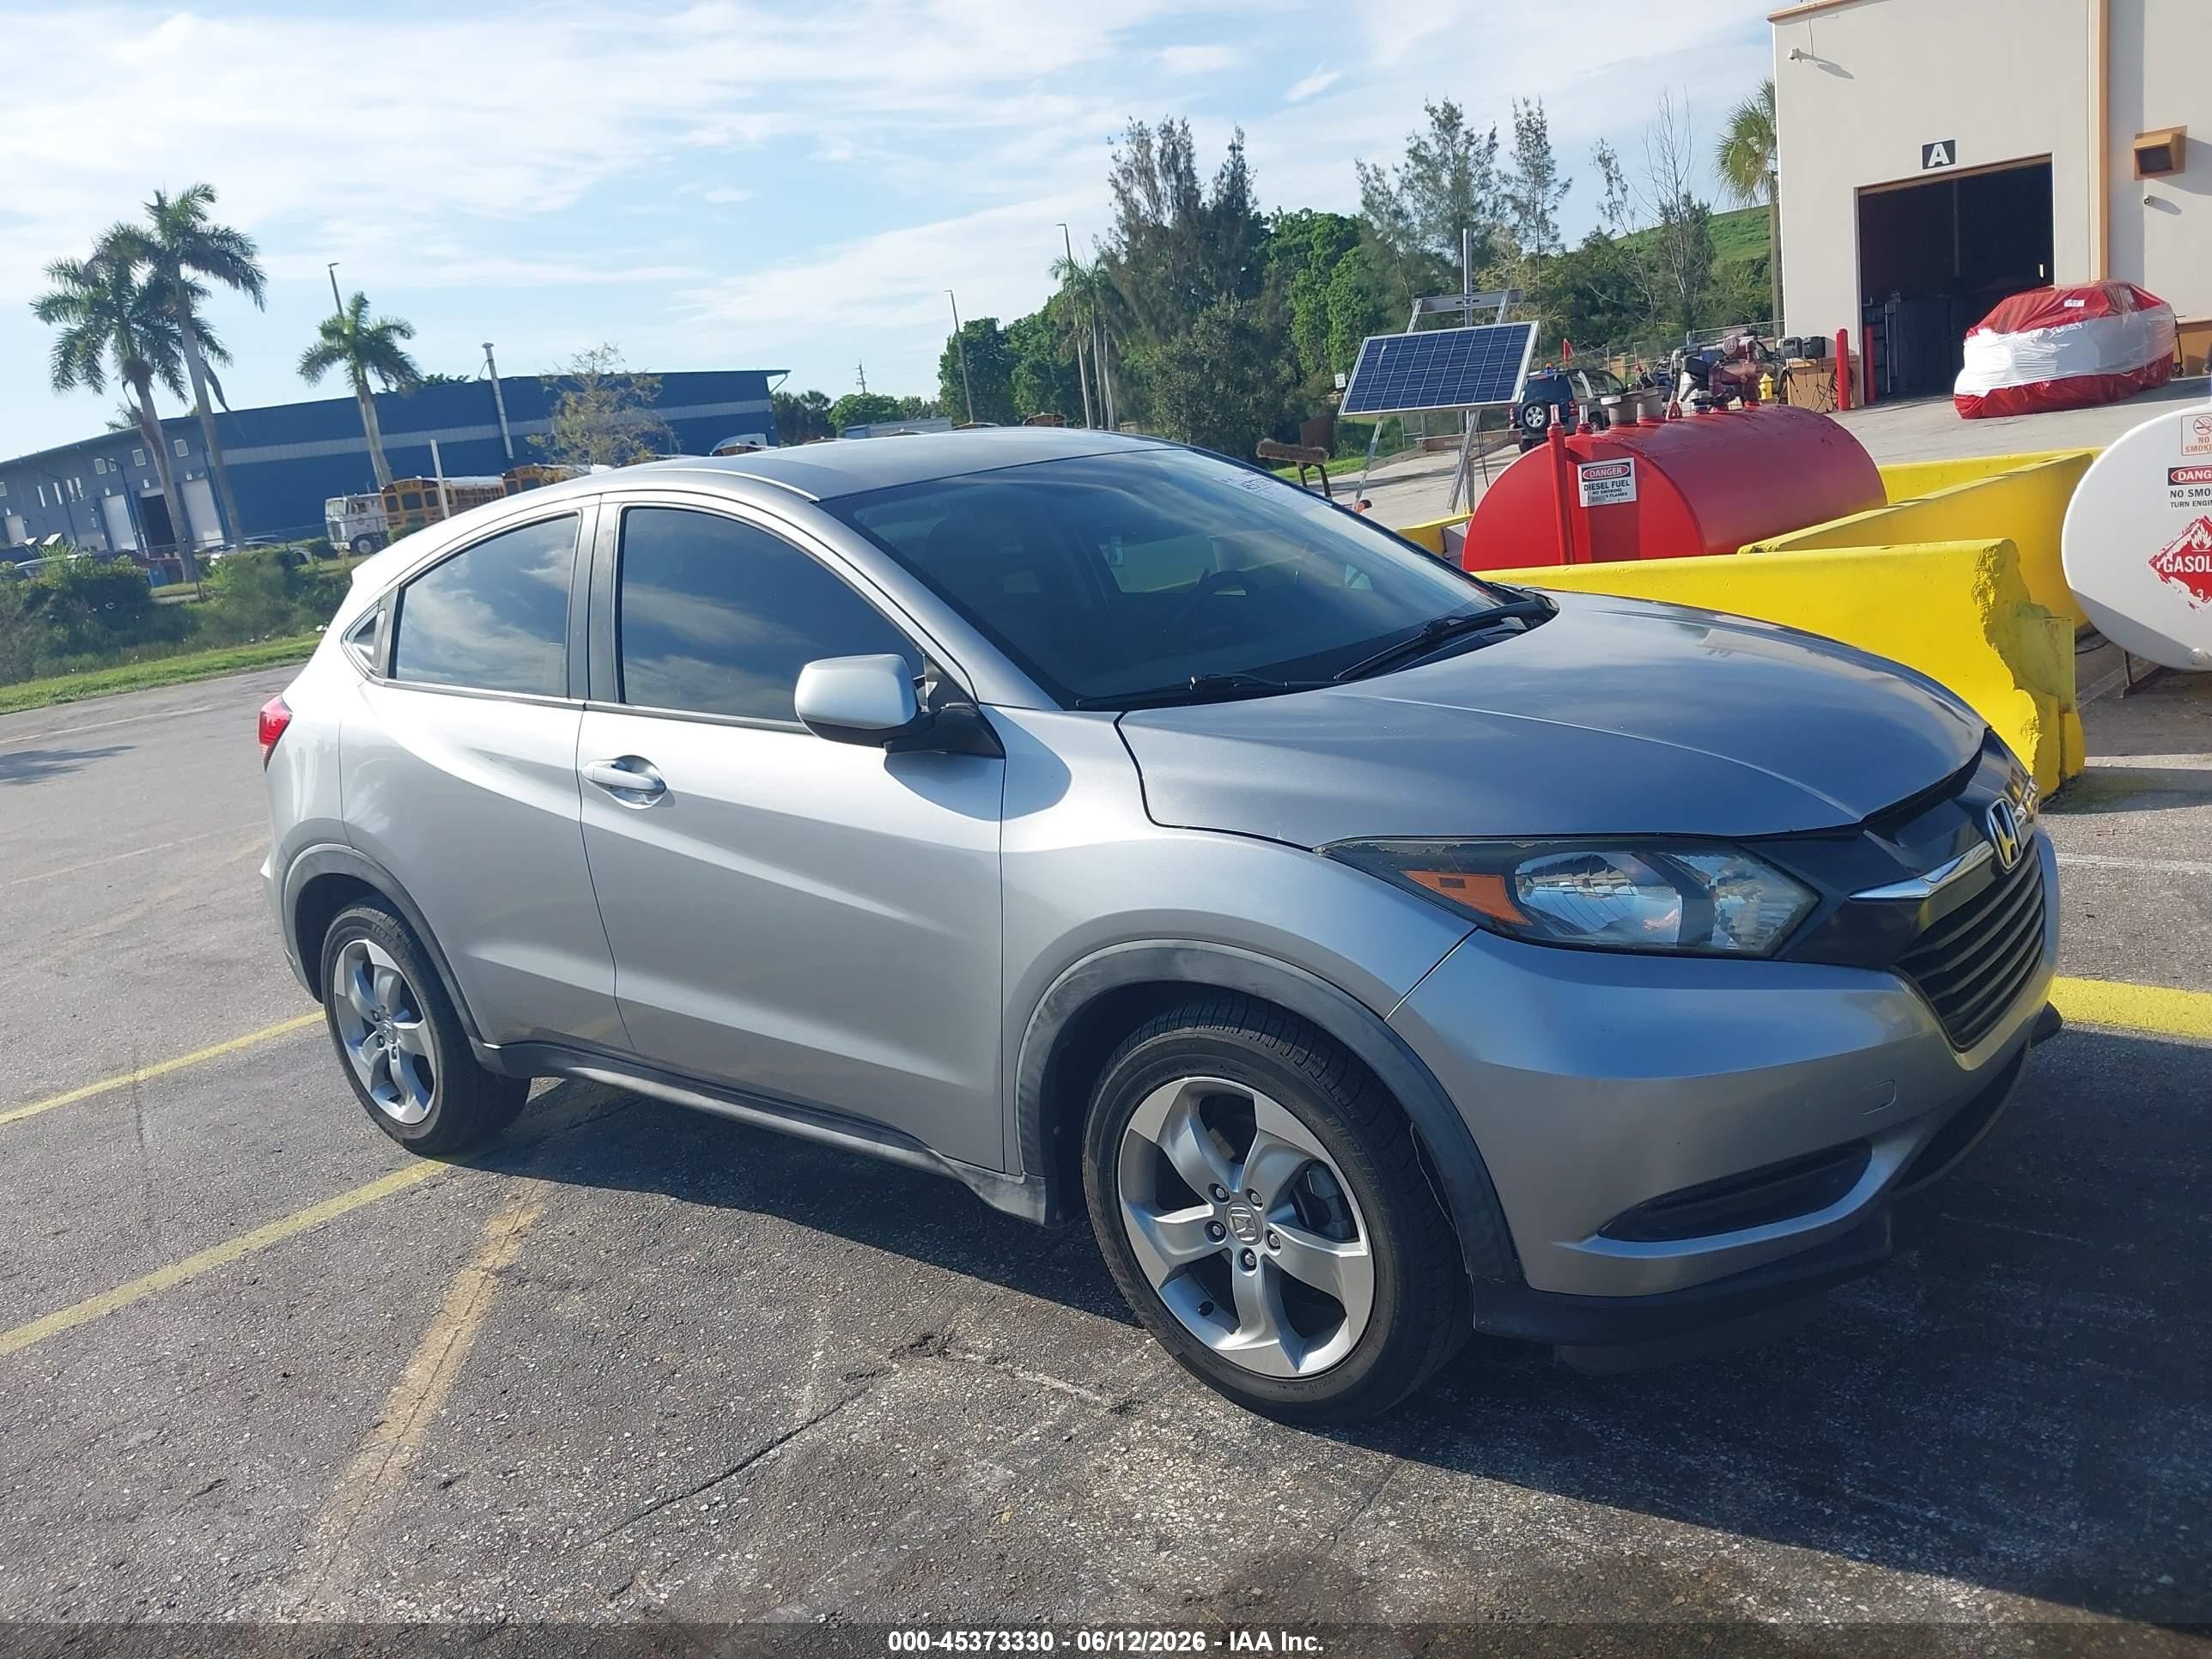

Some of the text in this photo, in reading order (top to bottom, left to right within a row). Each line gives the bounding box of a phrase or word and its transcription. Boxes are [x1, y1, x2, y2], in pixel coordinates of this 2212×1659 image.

[1927, 143, 1950, 167] A
[1589, 467, 1622, 477] DANGER
[1583, 482, 1609, 491] DIESEL
[2170, 488, 2212, 498] NO SMO
